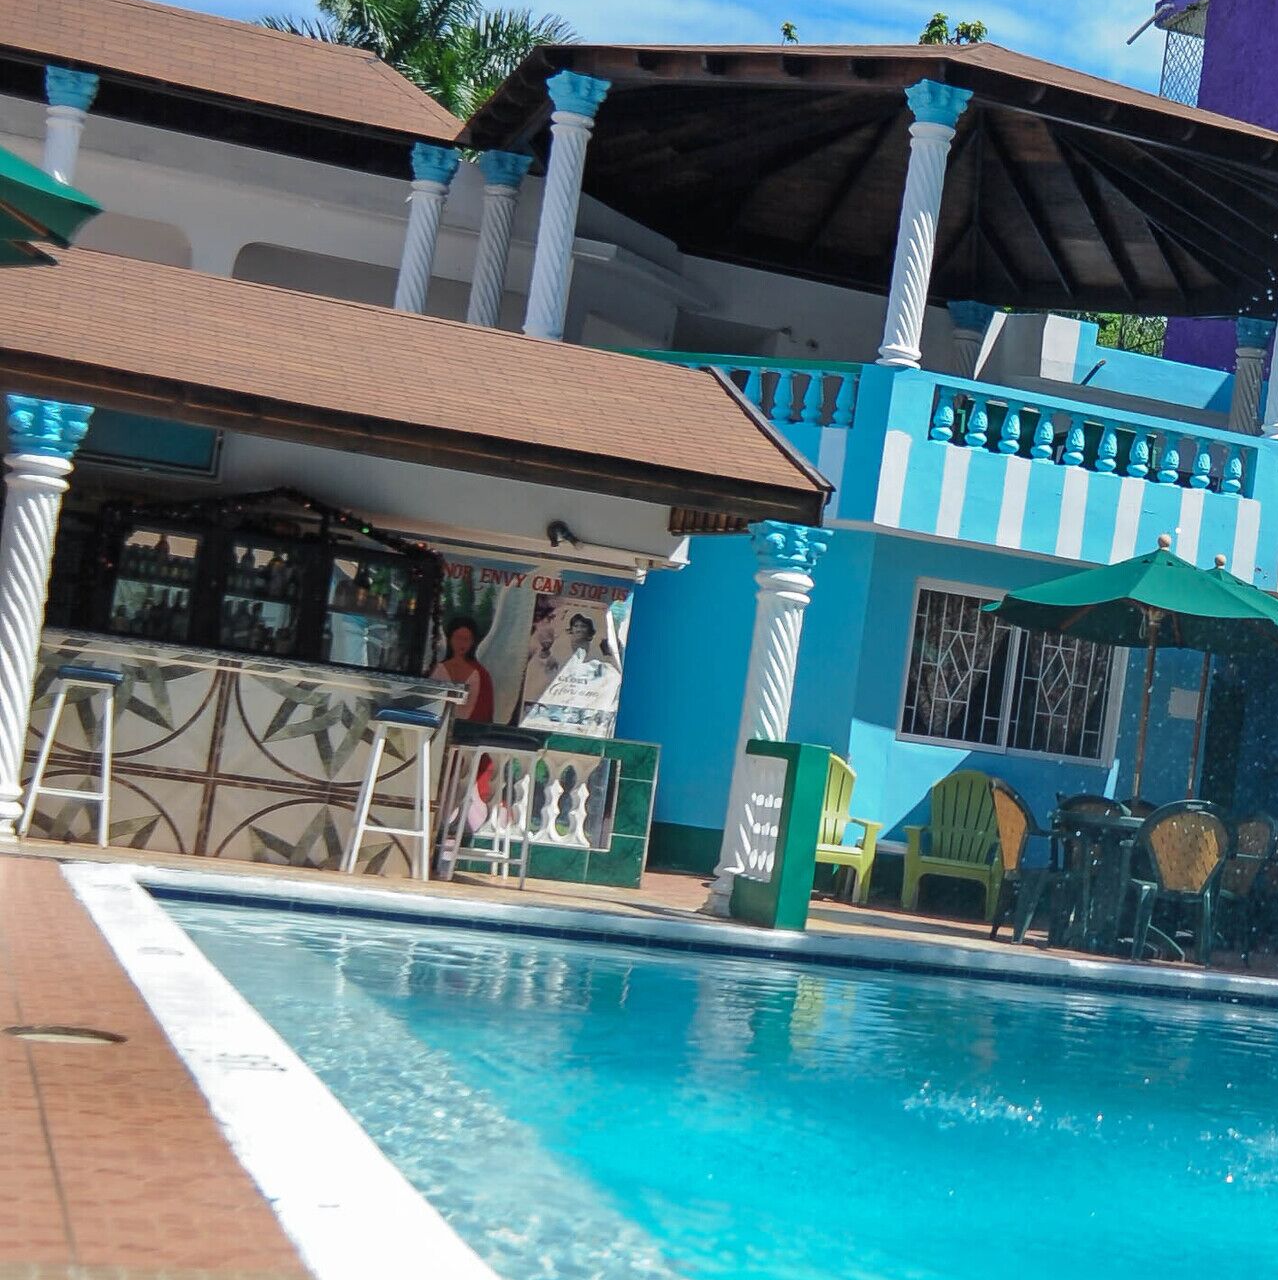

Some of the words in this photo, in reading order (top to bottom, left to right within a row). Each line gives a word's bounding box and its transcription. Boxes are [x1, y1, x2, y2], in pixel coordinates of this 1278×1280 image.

[480, 568, 527, 587] ENVY
[532, 576, 564, 593] CAN
[569, 581, 608, 600] STOP
